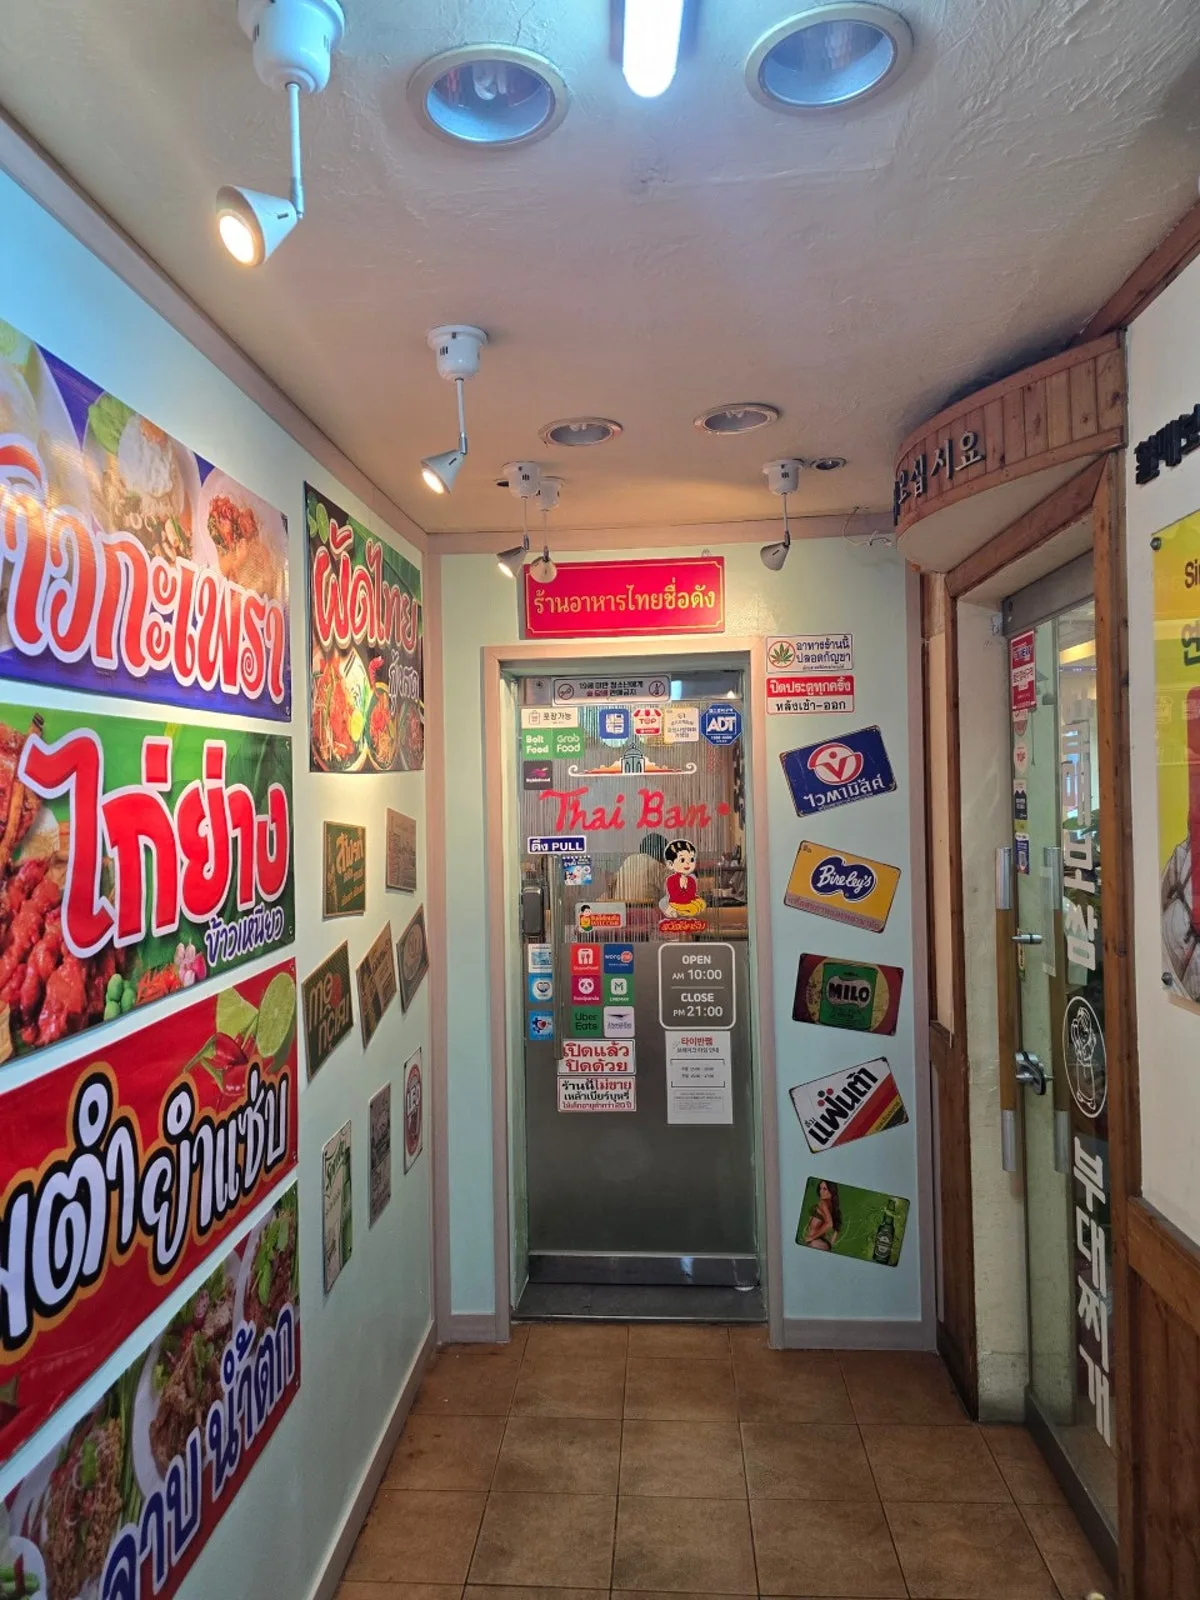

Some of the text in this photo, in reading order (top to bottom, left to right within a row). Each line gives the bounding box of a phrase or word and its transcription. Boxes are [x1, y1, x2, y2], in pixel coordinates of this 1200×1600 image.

[314, 519, 419, 653] ผัดไทย
[534, 576, 716, 615] ร้านอาหารไทยชื่อดัง
[796, 635, 850, 650] อาหารร้านนี้
[796, 652, 851, 665] ปลอดกัญชา
[770, 676, 851, 697] ปิดประตูทุกครั้ง
[776, 700, 846, 712] หลังเข้า-ออก
[707, 716, 736, 732] ADT
[526, 735, 544, 743] Bolt
[556, 734, 580, 743] Grab
[526, 745, 549, 754] Food
[556, 744, 580, 752] Food
[540, 786, 711, 833] Thai Ban
[19, 728, 289, 957] ไก่ย่าง
[531, 838, 583, 851] ดึง PULL
[817, 864, 872, 894] Bireley's
[204, 901, 284, 966] ข้าวเหนียว
[682, 955, 712, 964] OPEN
[672, 969, 722, 980] AM 10:00
[680, 993, 714, 1003] CLOSE
[828, 981, 870, 1003] MILO
[575, 1013, 598, 1021] Uber
[673, 1006, 723, 1017] PM 21:00
[575, 1023, 598, 1031] Eats
[563, 1041, 630, 1057] เปิดแล้ว
[566, 1058, 629, 1072] ปิดด้วย
[562, 1078, 632, 1091] ร้านนี้ไม่ขาย
[564, 1090, 630, 1102] เหล้าเบียร์บุหรี่
[207, 1304, 294, 1499] น้ำตก
